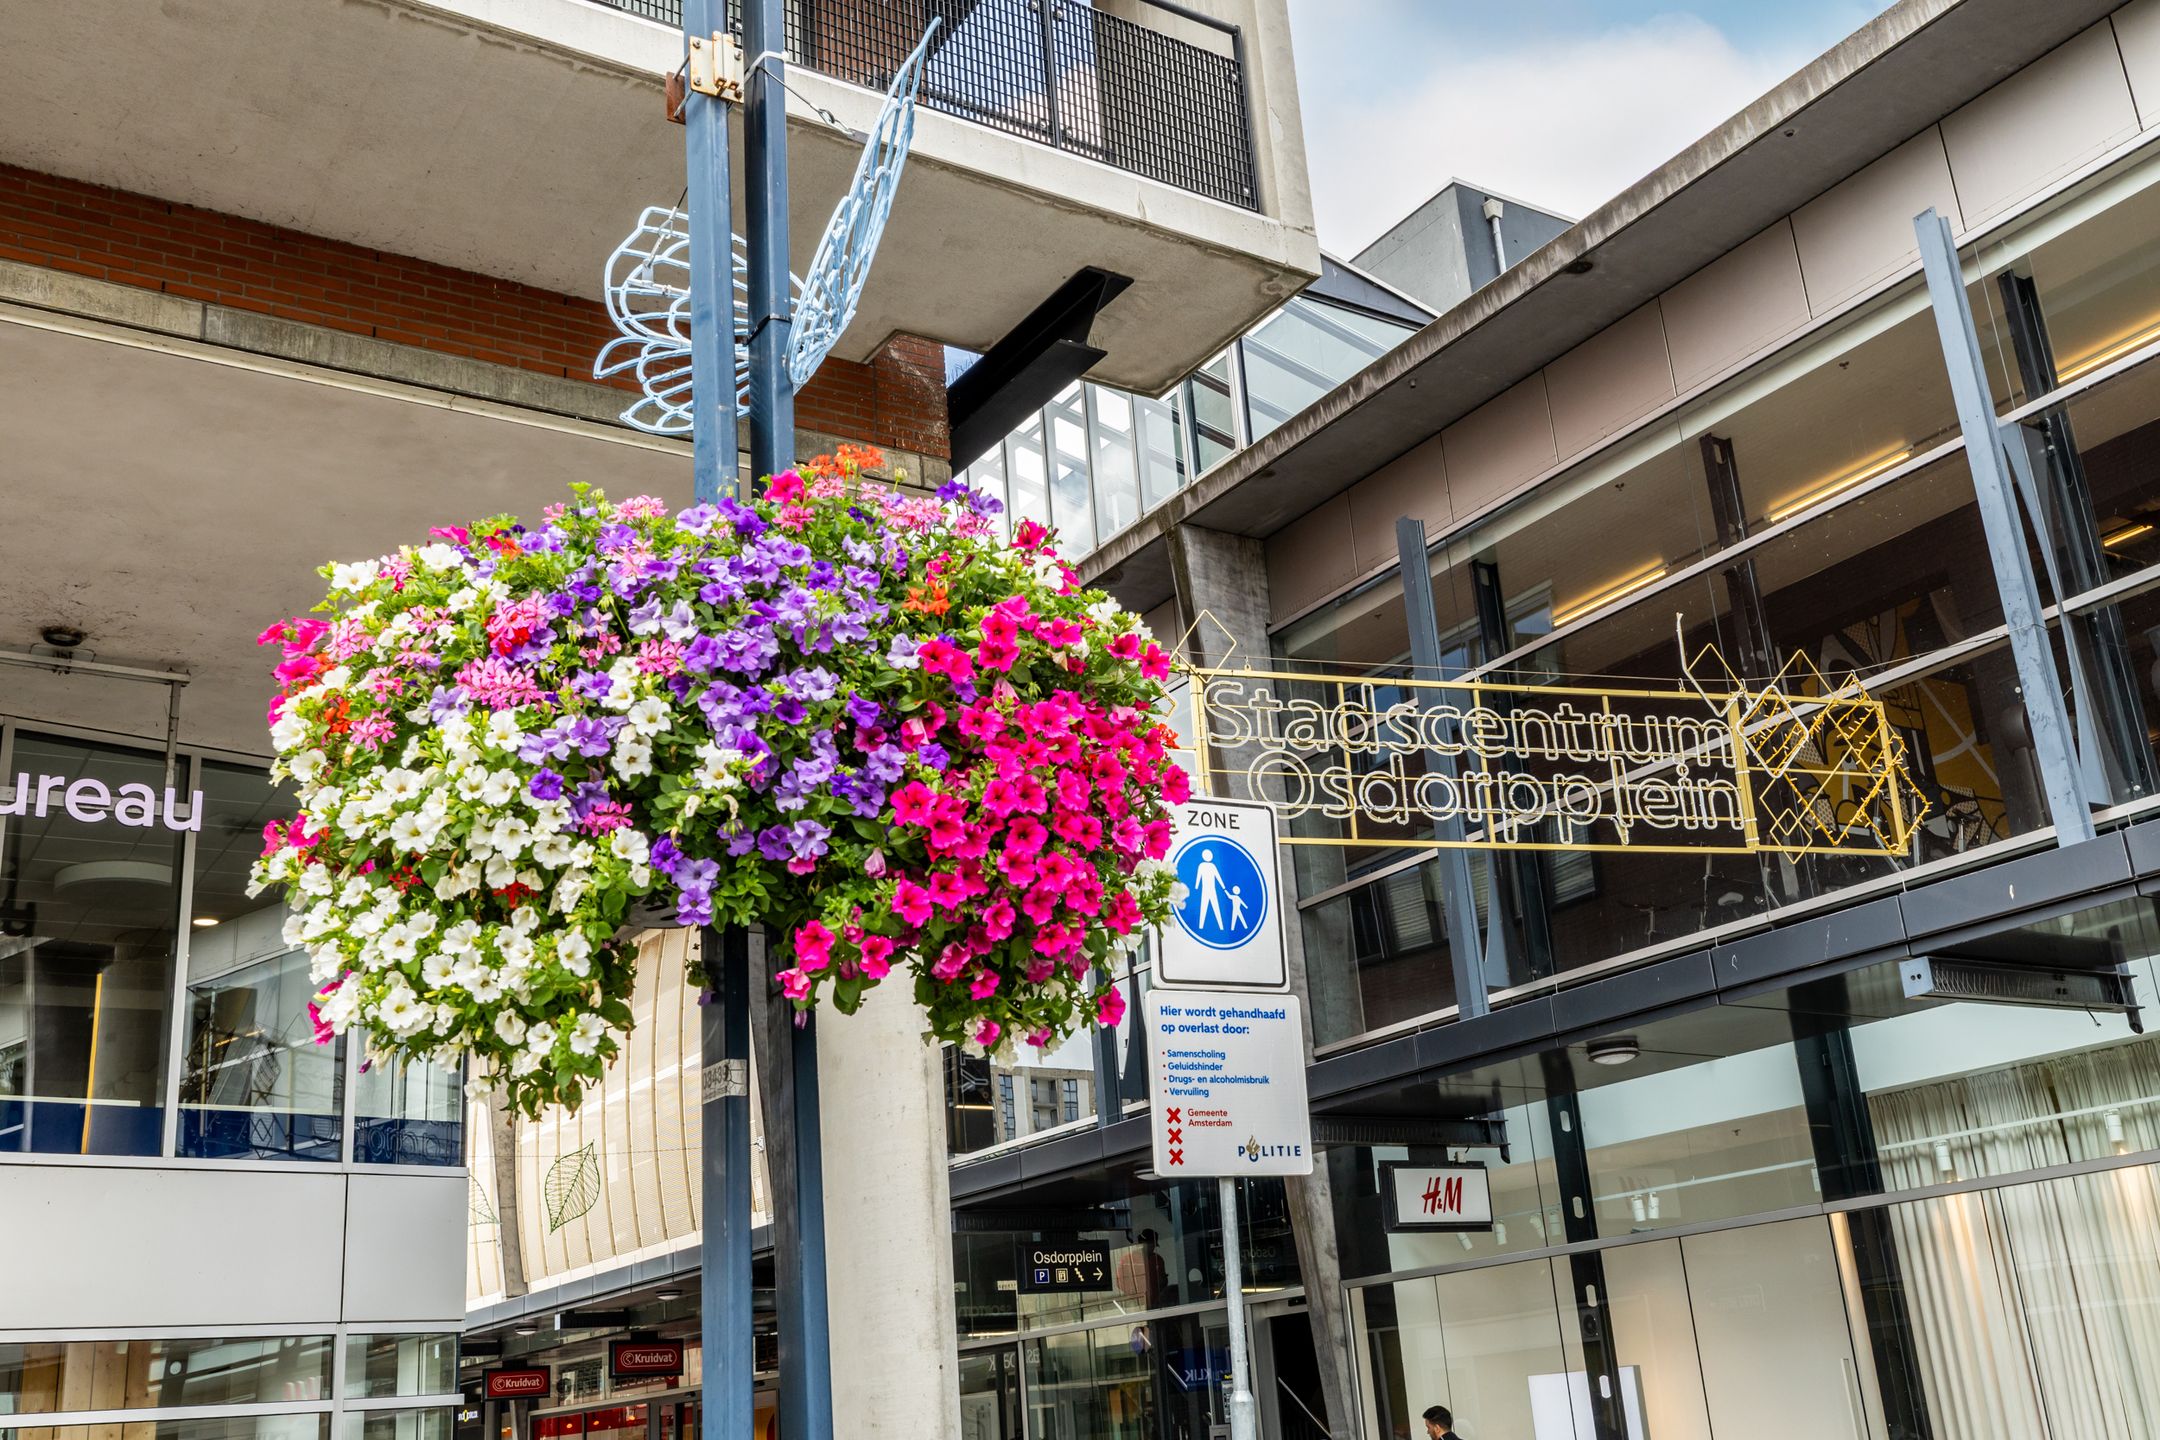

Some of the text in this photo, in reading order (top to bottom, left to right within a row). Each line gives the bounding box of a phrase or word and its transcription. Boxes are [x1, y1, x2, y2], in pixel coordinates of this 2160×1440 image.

[1206, 680, 1736, 768] Stadscentrum
[1248, 751, 1744, 845] Osdorpplein
[1188, 811, 1239, 830] ZONE
[1160, 1006, 1285, 1019] Hier wordt gehandhaafd
[1161, 1023, 1249, 1034] op overlast door:
[1167, 1050, 1225, 1060] Samenscholing
[1168, 1062, 1222, 1071] Geluidshinder
[1169, 1075, 1195, 1085] Drugs-
[1210, 1076, 1269, 1084] alcoholmisbruik
[1170, 1088, 1209, 1097] Vervuiling
[1188, 1109, 1227, 1117] Gemeente
[1188, 1119, 1232, 1127] Amsterdam
[1422, 1177, 1462, 1215] H&M
[1034, 1250, 1102, 1266] Osdorpplein
[635, 1352, 673, 1364] Kruidvat
[505, 1377, 540, 1389] Kruidvat
